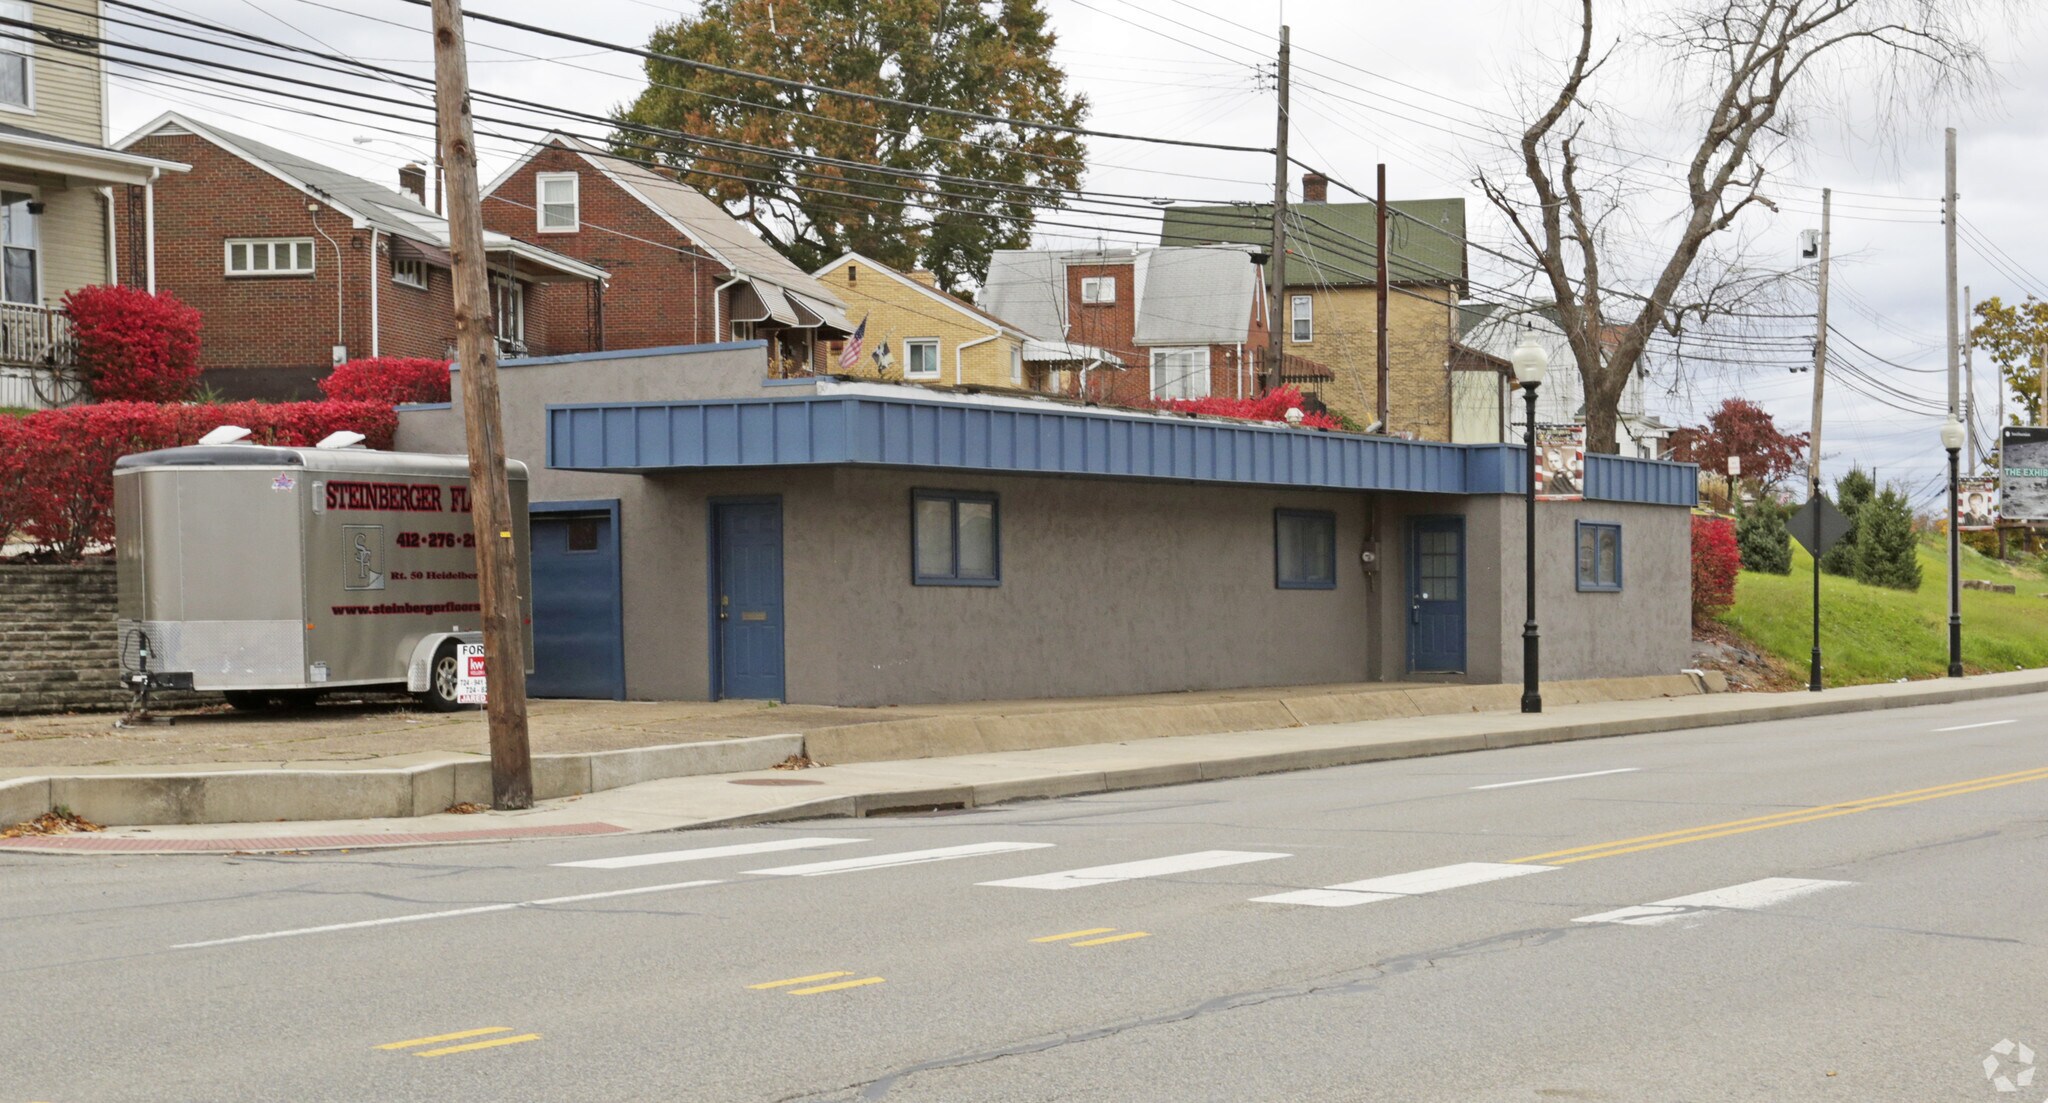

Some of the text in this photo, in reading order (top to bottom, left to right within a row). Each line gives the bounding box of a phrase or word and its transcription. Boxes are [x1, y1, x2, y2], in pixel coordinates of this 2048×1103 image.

[2004, 468, 2048, 477] THE EXHIB
[326, 480, 443, 513] STEINBERGER
[390, 571, 407, 580] Rt.
[410, 571, 424, 580] 50
[462, 645, 484, 655] FOR
[470, 658, 485, 670] kw
